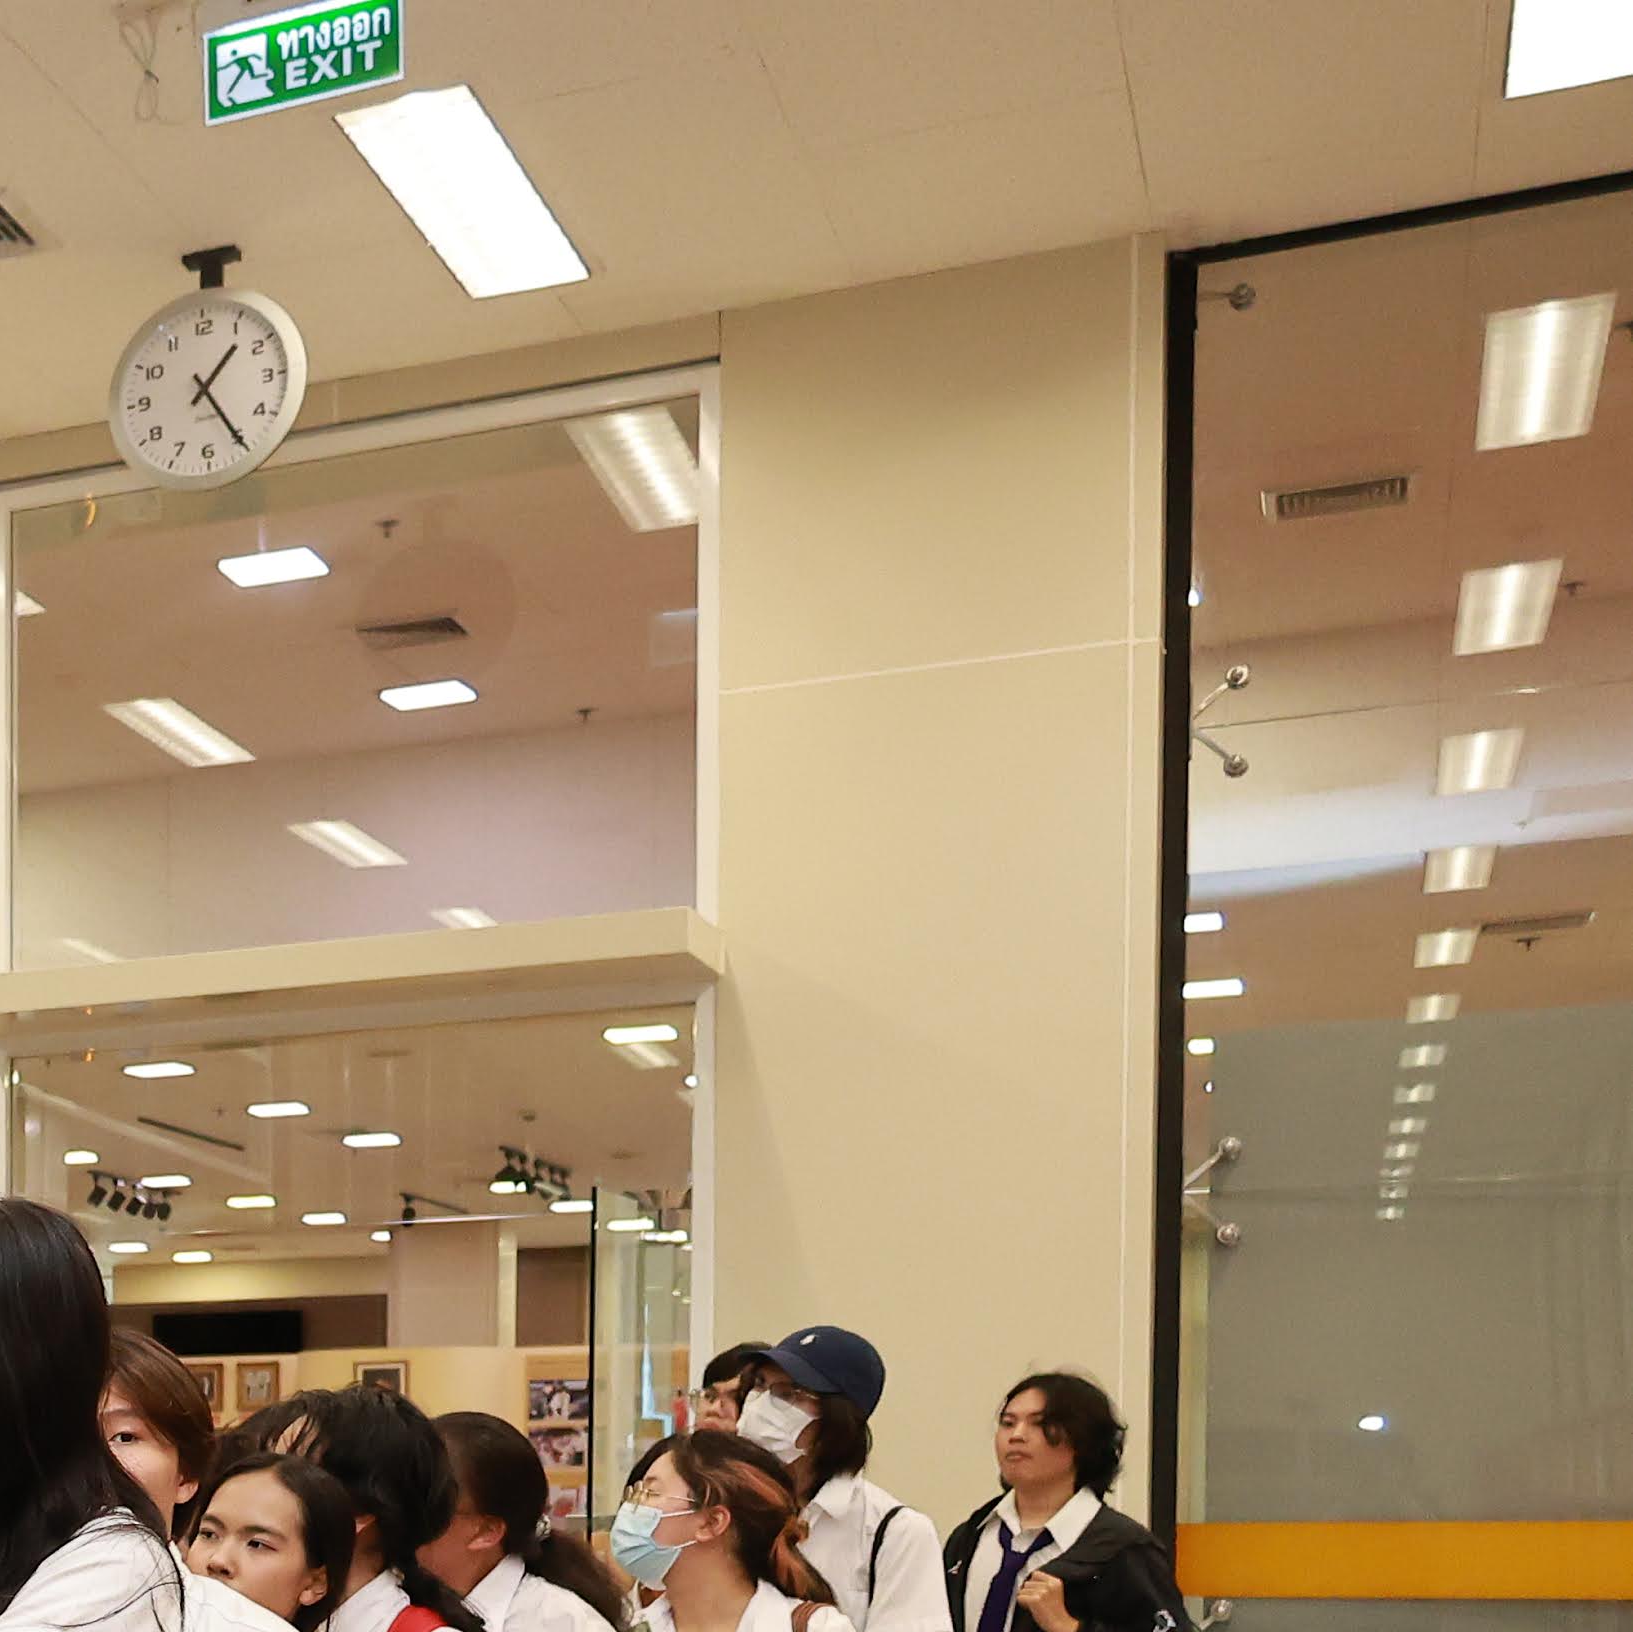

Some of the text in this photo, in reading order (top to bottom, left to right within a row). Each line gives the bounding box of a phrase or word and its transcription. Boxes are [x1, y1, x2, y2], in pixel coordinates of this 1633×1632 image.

[276, 6, 391, 61] ทางออก
[285, 40, 383, 90] EXIT
[195, 320, 213, 336] 12
[168, 336, 179, 352] 11
[252, 340, 265, 355] 2
[146, 364, 164, 380] 10
[262, 368, 274, 383] 3
[138, 397, 151, 412] 9
[253, 402, 266, 416] 4
[149, 426, 163, 441] 8
[174, 441, 186, 457] 7
[201, 443, 215, 459] 6
